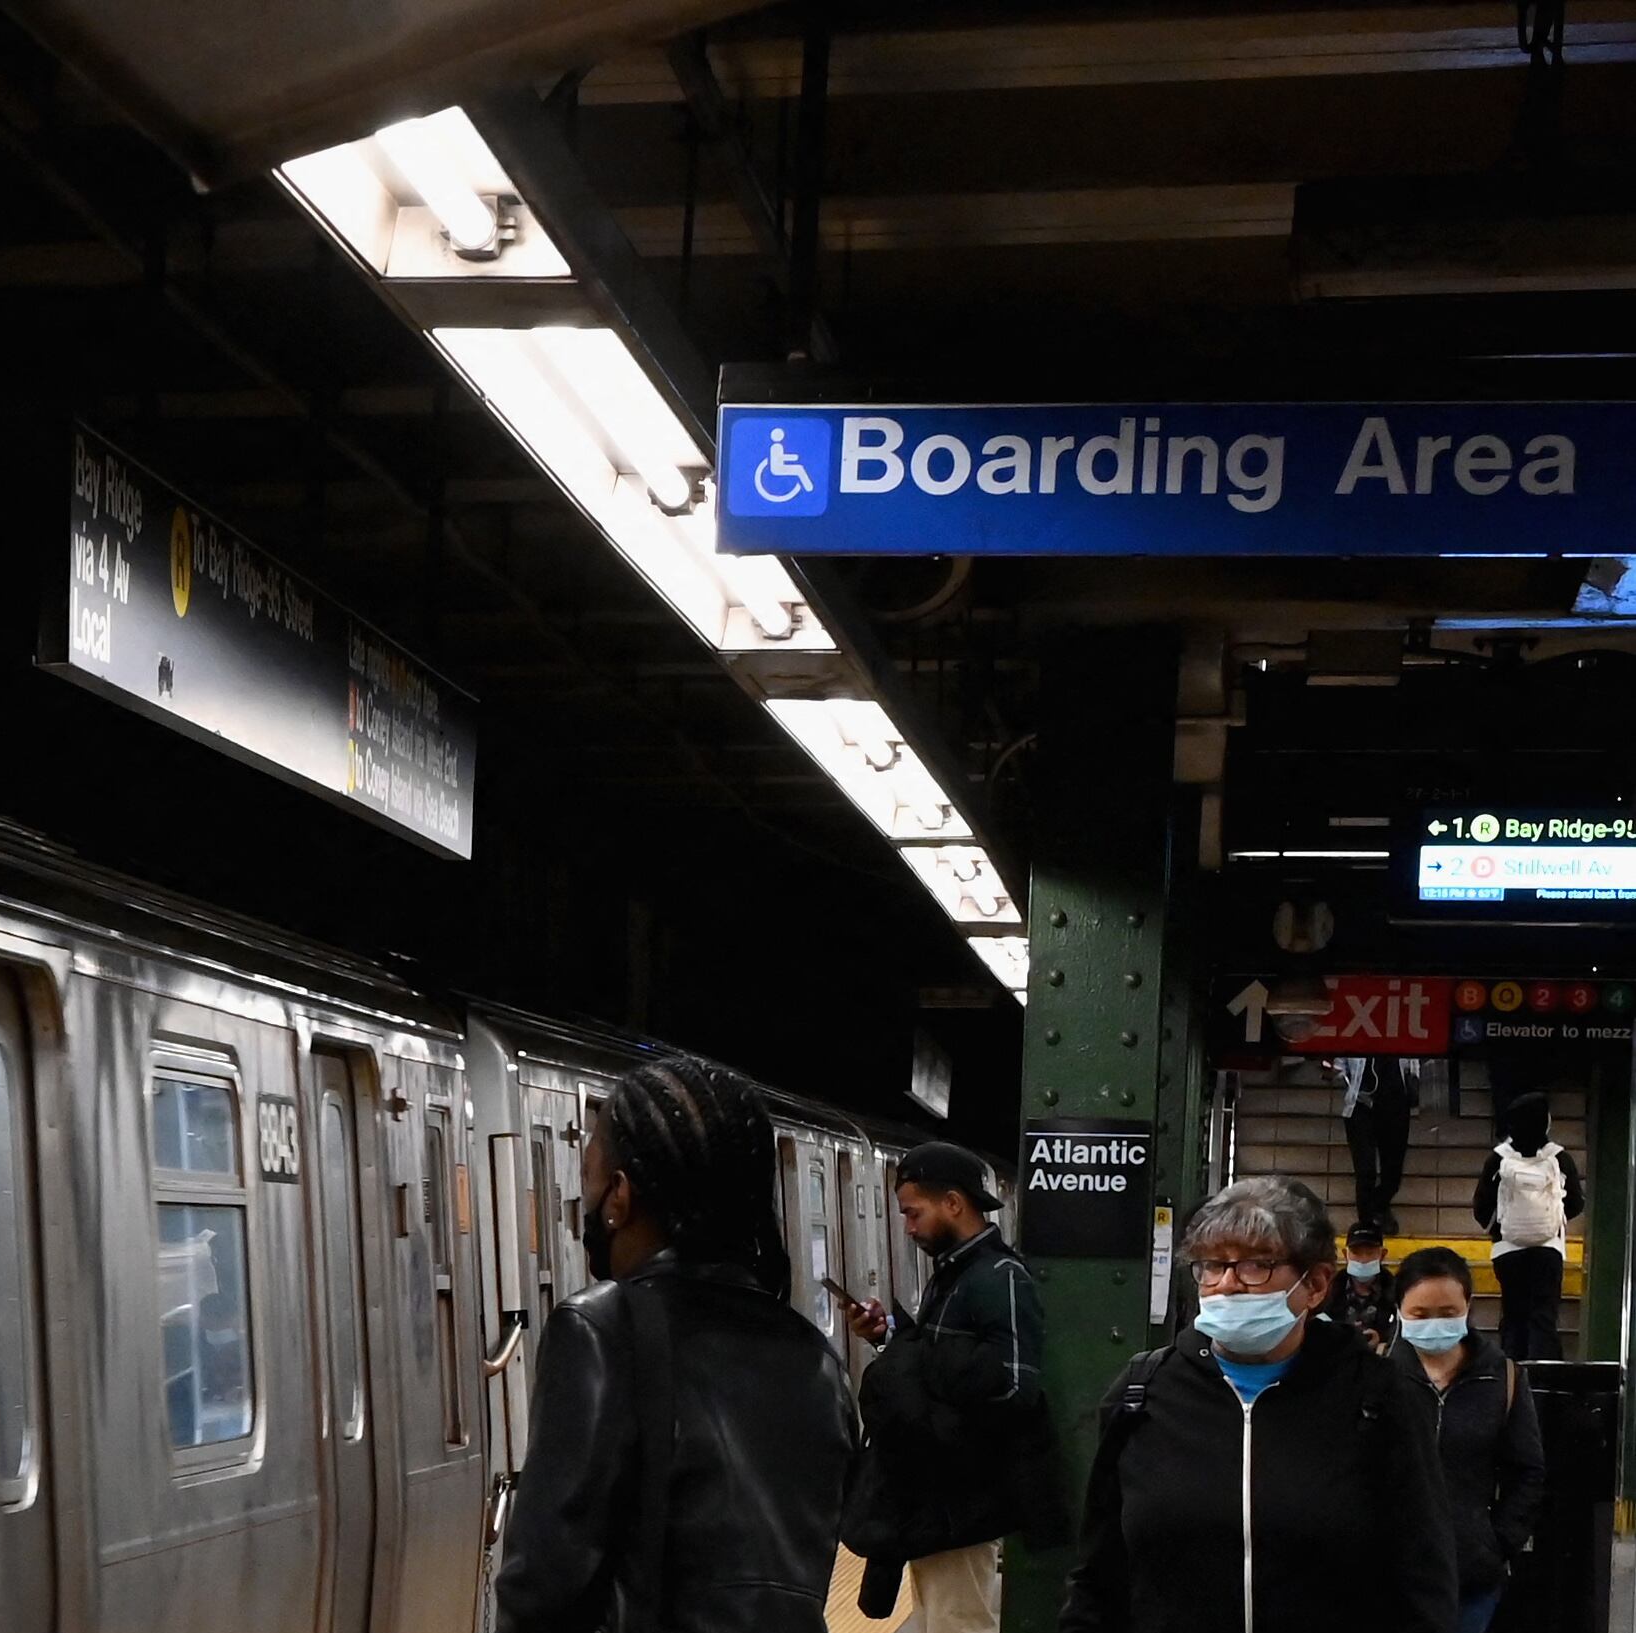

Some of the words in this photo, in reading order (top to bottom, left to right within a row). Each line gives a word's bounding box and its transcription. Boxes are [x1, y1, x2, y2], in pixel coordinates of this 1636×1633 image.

[75, 435, 101, 519] Bay
[105, 455, 142, 543] Ridge
[838, 416, 1285, 513] Boarding
[1334, 416, 1577, 496] Area
[74, 520, 94, 586] via
[98, 533, 110, 593] 4
[113, 541, 131, 604] Av
[192, 514, 206, 574] To
[208, 525, 230, 600] Bay
[72, 586, 111, 664] Local
[356, 687, 365, 734] to
[355, 743, 365, 790] to
[365, 746, 390, 812] Coney
[1480, 822, 1491, 835] R
[1505, 818, 1544, 843] Bay
[1588, 860, 1614, 877] Av
[1463, 988, 1478, 1004] B
[1499, 988, 1515, 1006] Q
[1537, 988, 1551, 1006] 2
[1574, 988, 1589, 1006] 3
[1610, 988, 1625, 1006] 4
[1486, 1022, 1555, 1038] Elevator
[1562, 1023, 1580, 1039] to
[259, 1102, 299, 1175] 8843
[1030, 1138, 1146, 1165] Atlantic
[1028, 1168, 1127, 1192] Avenue
